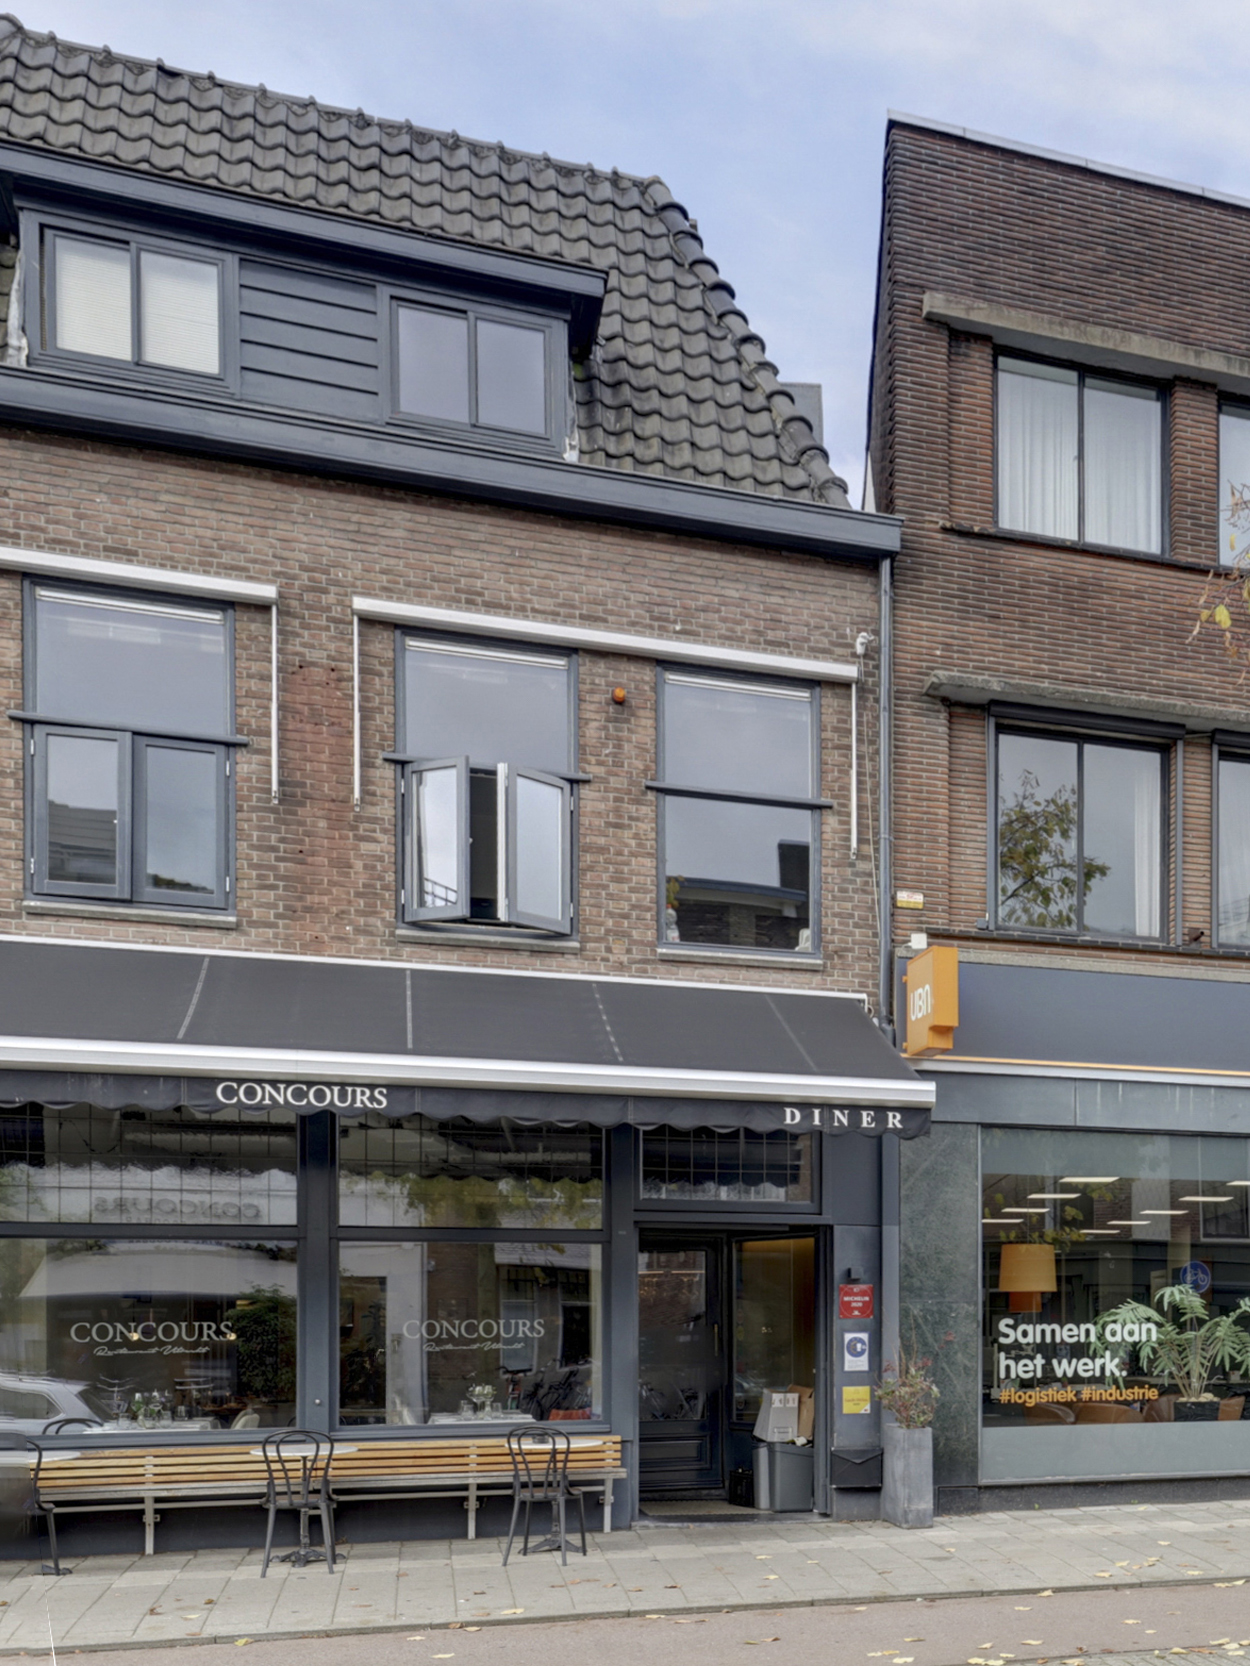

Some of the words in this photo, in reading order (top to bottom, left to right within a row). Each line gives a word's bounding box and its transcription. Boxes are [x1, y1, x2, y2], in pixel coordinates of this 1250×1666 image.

[216, 1081, 388, 1109] CONCOURS
[783, 1106, 903, 1129] DINER
[70, 1322, 233, 1343] CONCOURS
[402, 1319, 546, 1339] CONCOURS
[998, 1317, 1096, 1345] Samen
[1105, 1322, 1158, 1343] aan
[999, 1350, 1046, 1379] het
[1051, 1350, 1128, 1378] werk.
[1000, 1386, 1078, 1407] #logistiek
[1080, 1384, 1159, 1401] #industrie
